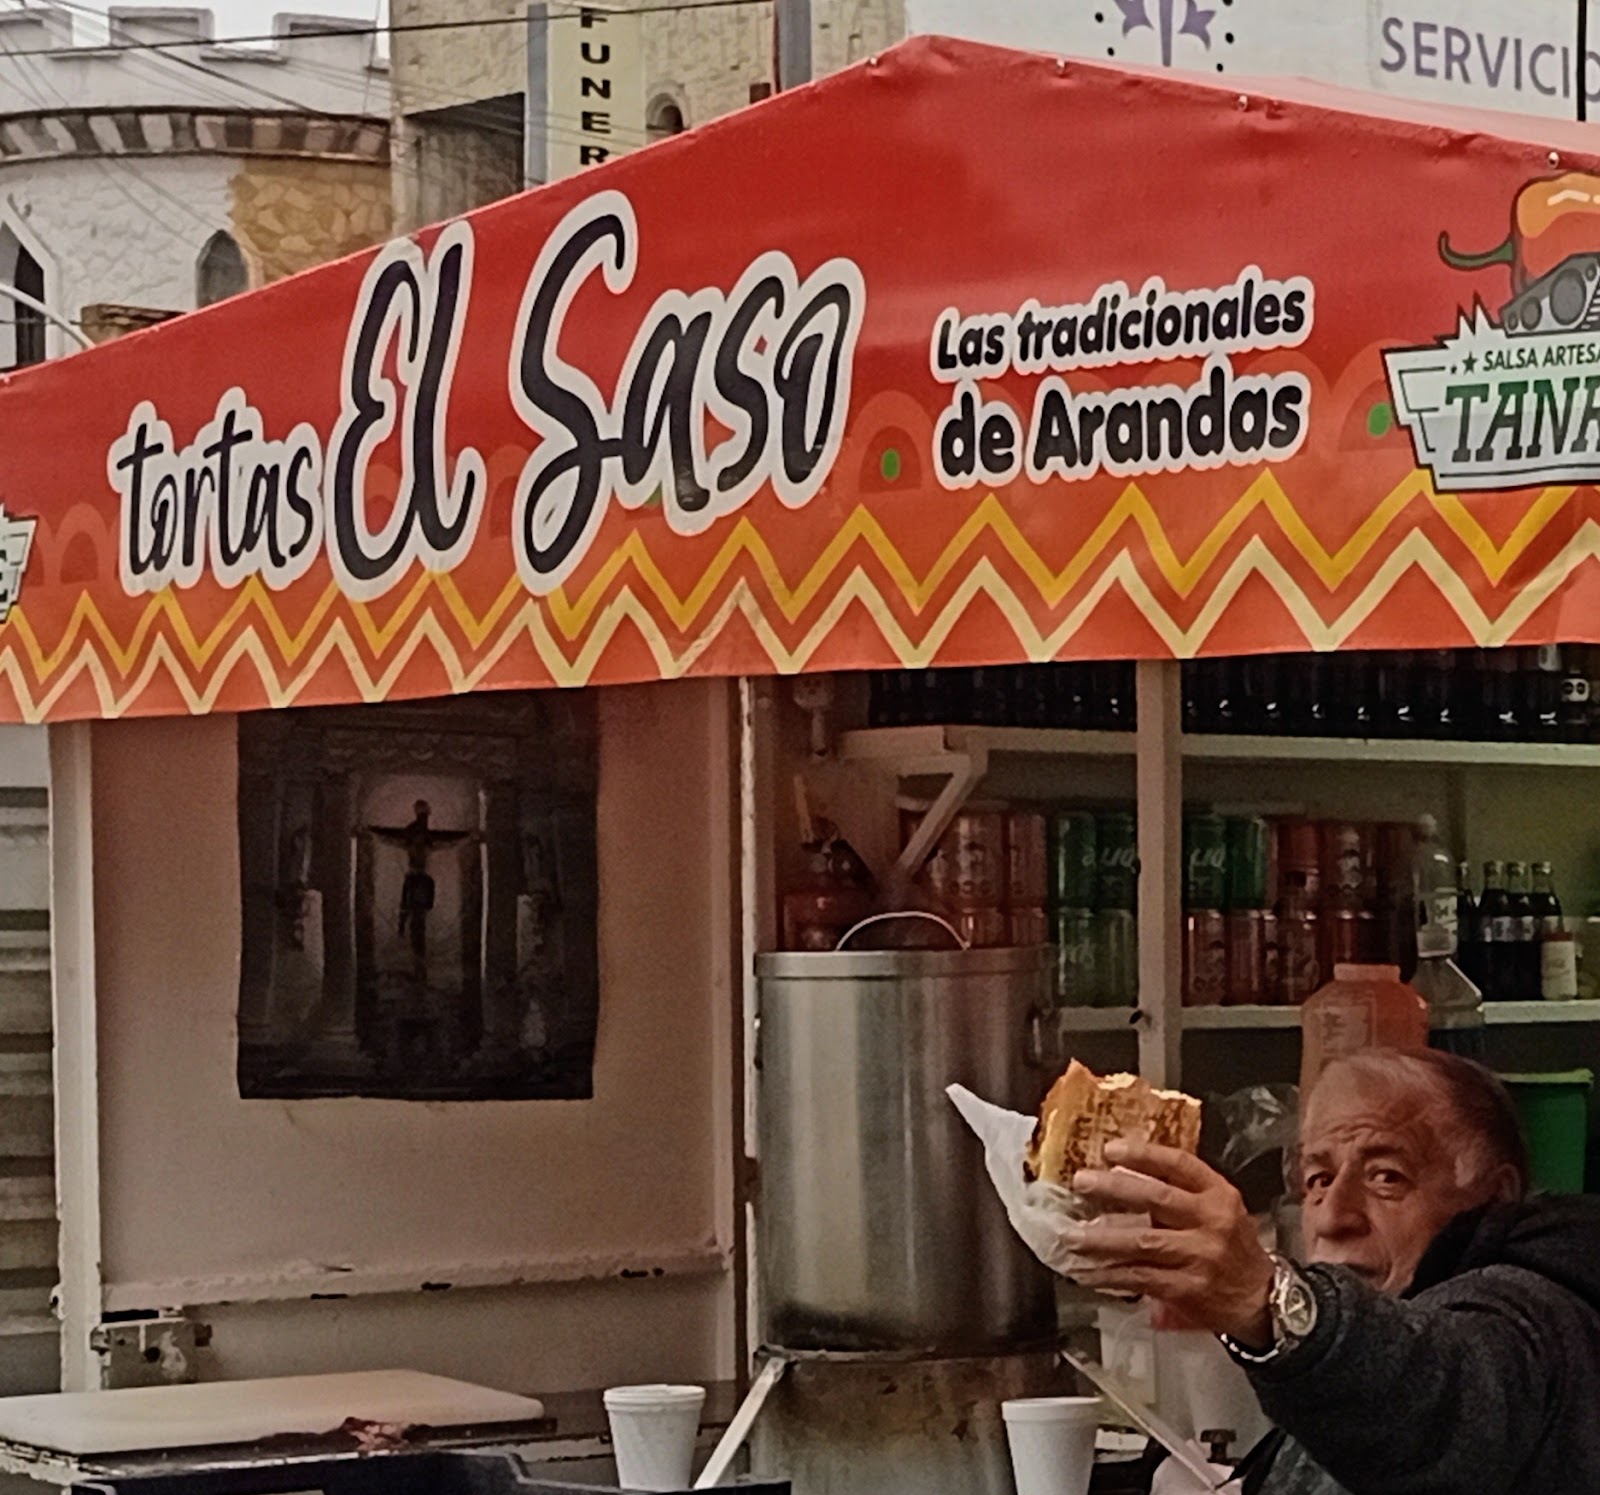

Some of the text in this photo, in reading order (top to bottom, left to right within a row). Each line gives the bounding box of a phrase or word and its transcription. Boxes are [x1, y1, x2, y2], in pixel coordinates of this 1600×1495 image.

[937, 279, 1306, 370] Las tradicionales
[1484, 347, 1538, 373] SALSA
[117, 213, 850, 581] tortas El Saso
[941, 366, 1303, 477] de Arandas
